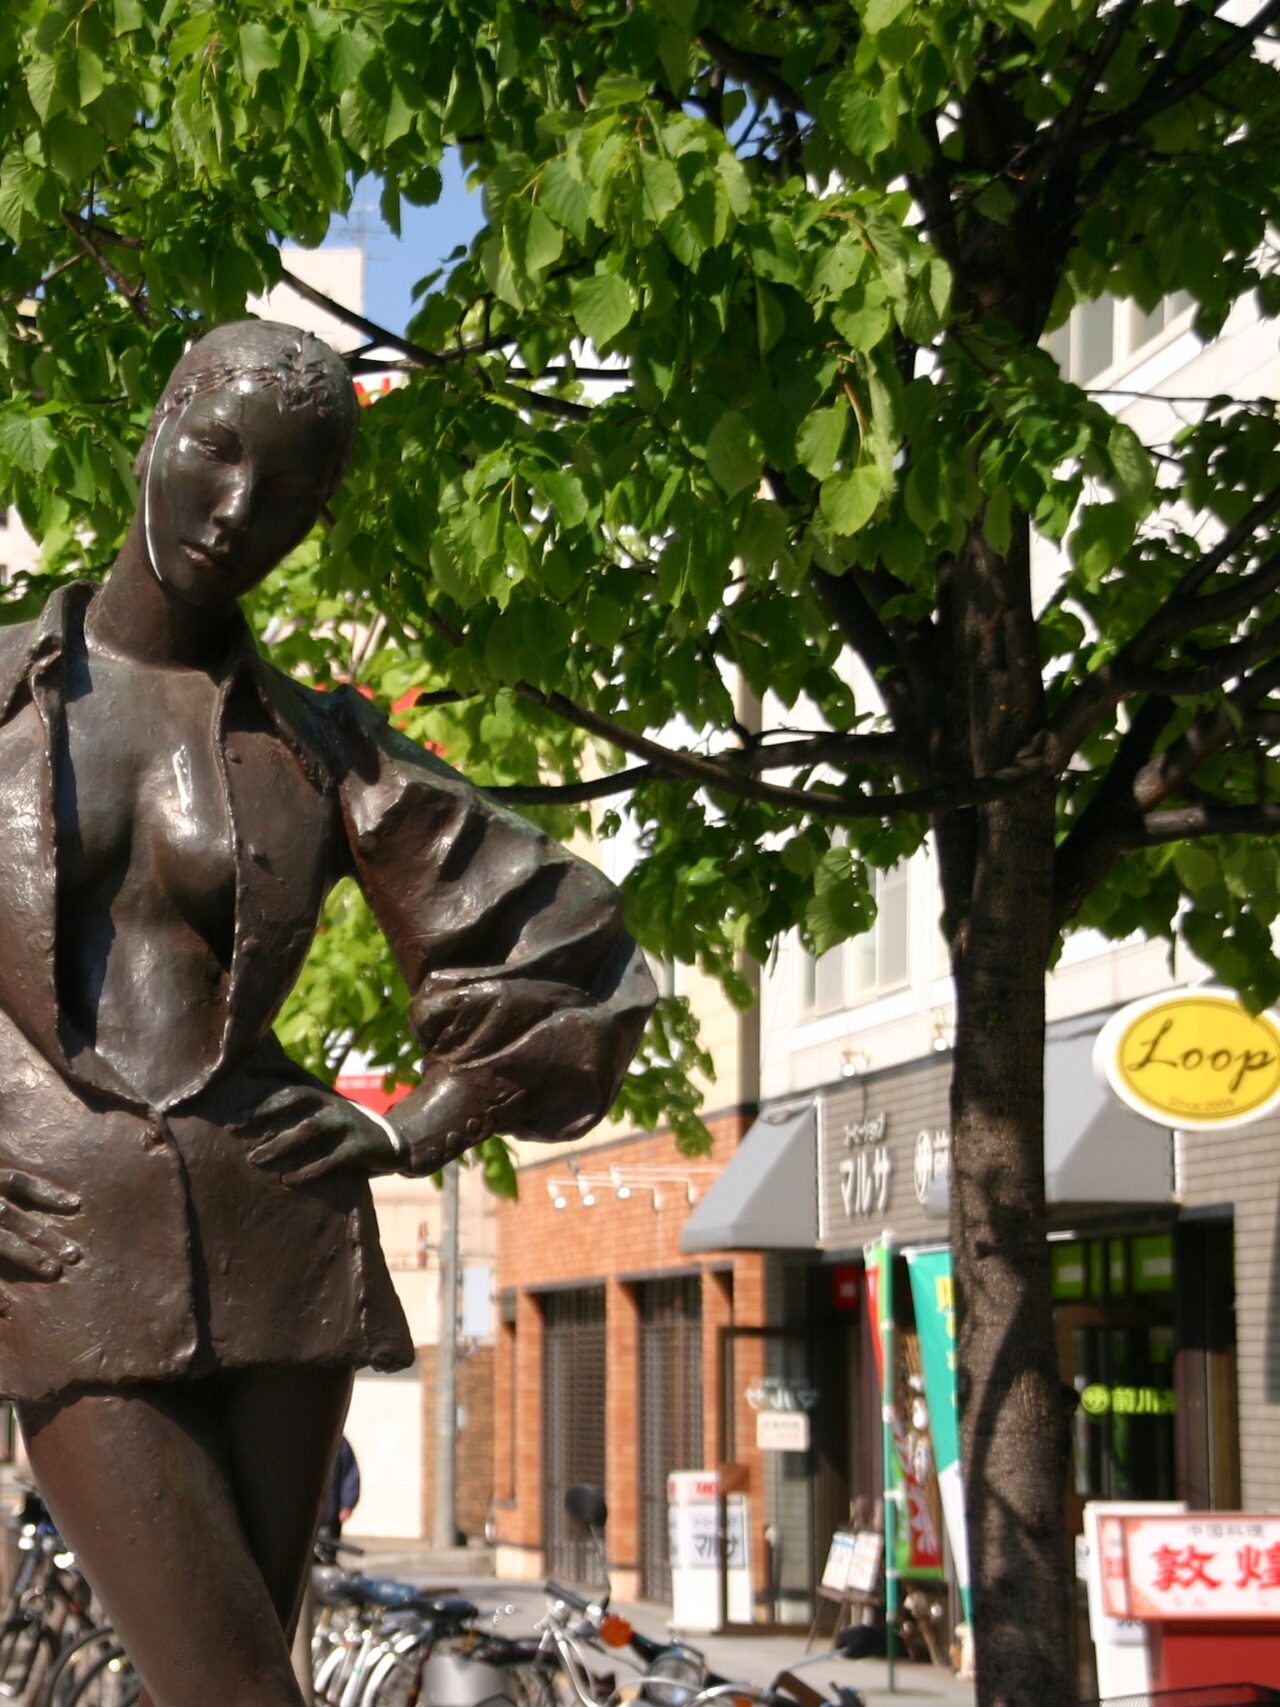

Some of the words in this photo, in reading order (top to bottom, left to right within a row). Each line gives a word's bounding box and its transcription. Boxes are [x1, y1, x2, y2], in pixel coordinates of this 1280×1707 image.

[1127, 1018, 1276, 1094] Loop
[839, 1146, 890, 1217] マルサ
[1187, 1514, 1264, 1539] 中国料理
